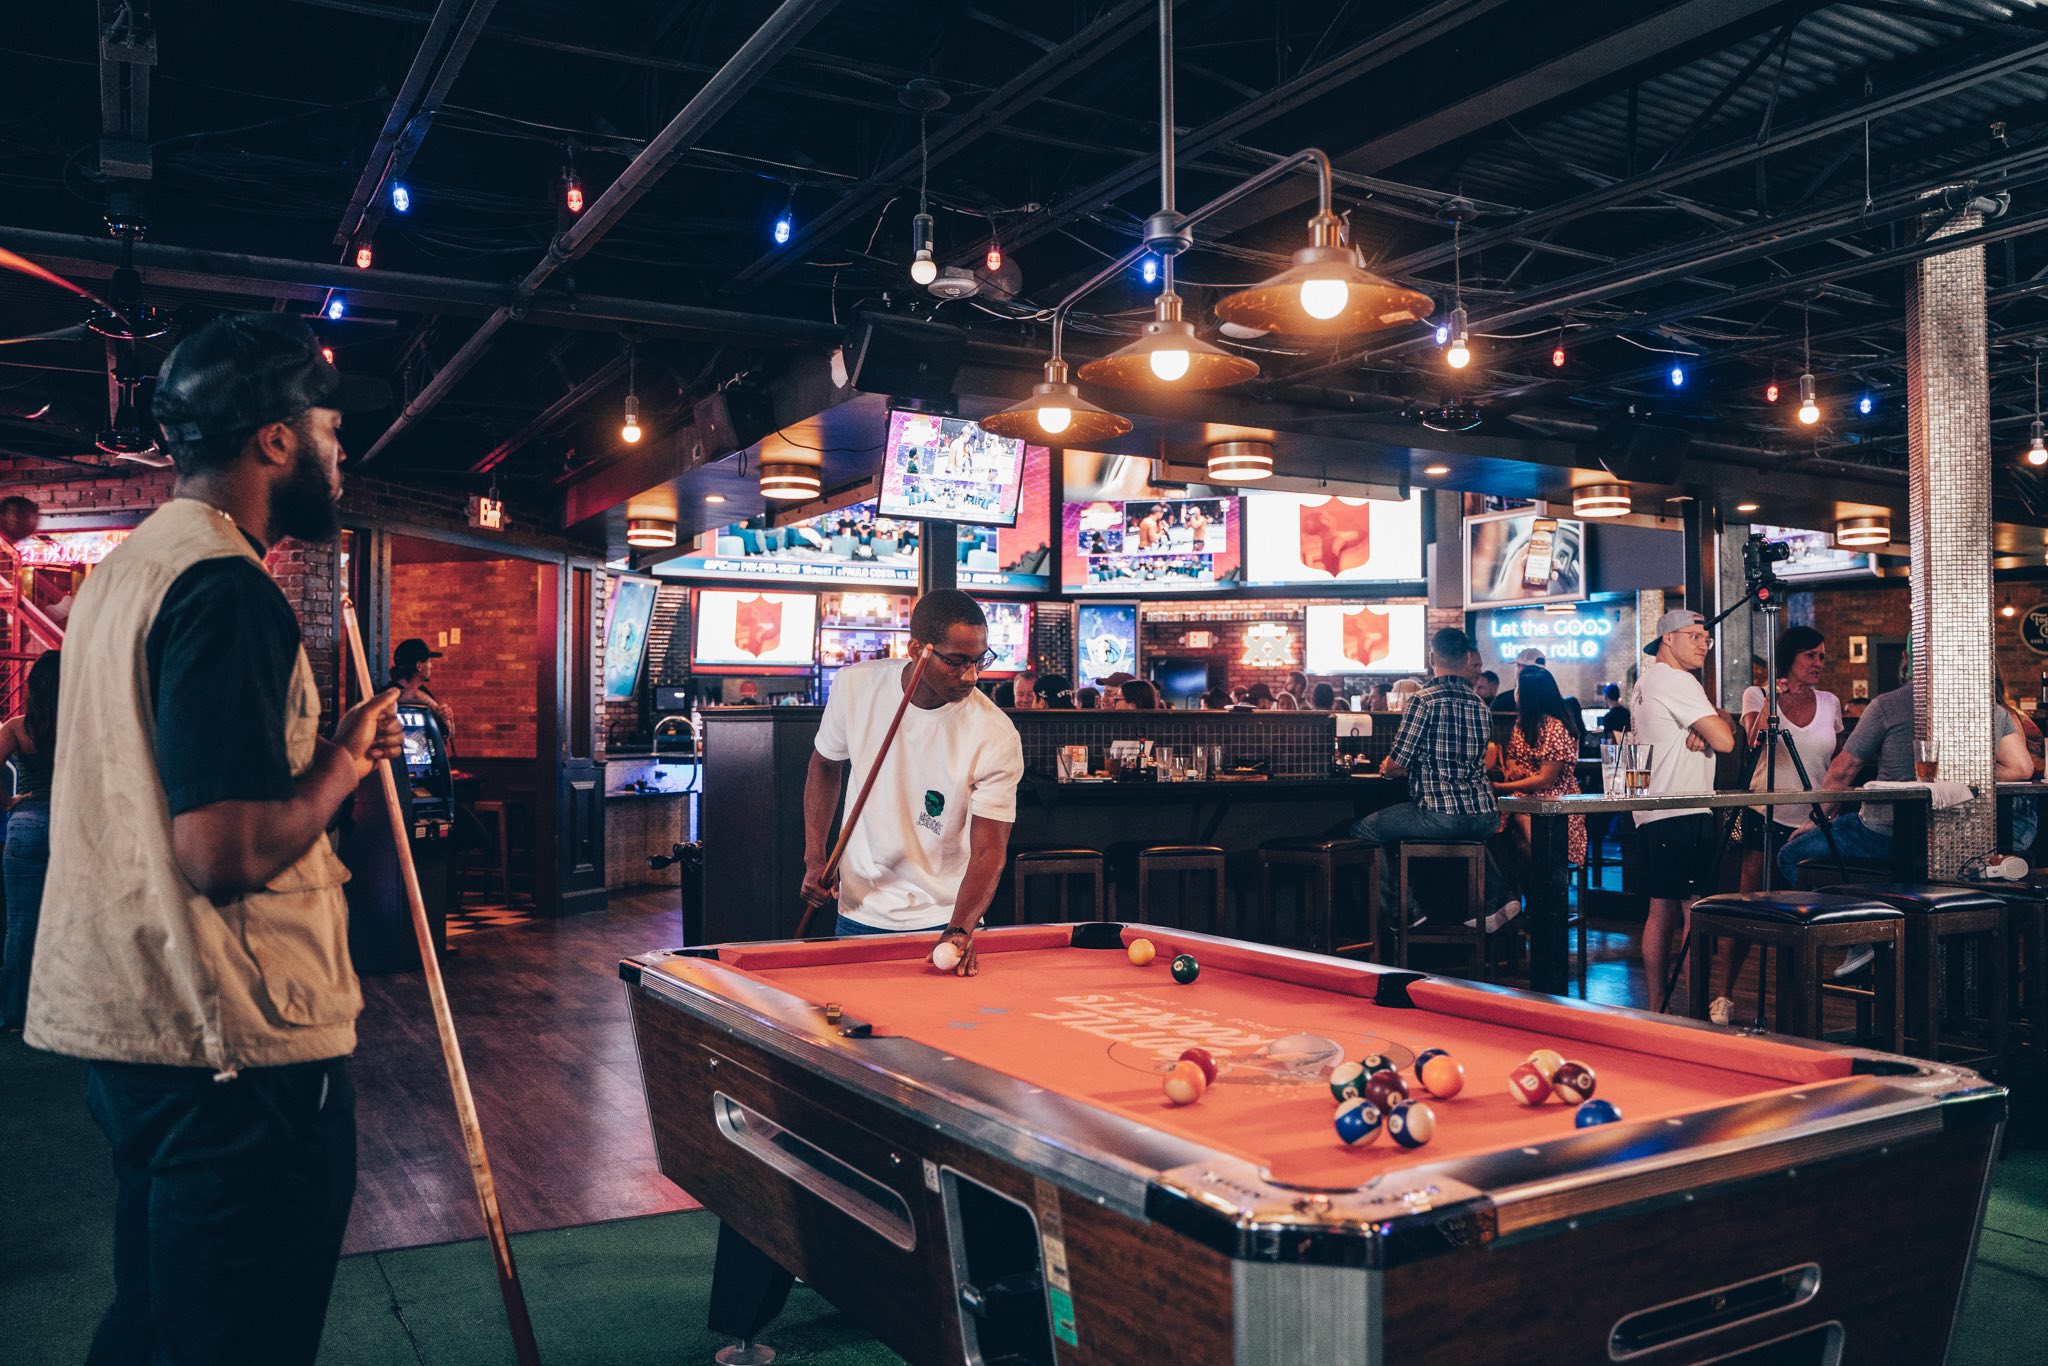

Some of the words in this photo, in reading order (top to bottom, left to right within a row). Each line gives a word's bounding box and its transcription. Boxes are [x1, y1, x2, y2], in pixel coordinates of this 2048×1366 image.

[741, 562, 800, 574] PAY-PER-VIEW
[870, 568, 897, 579] COSTA
[1491, 619, 1519, 637] Let
[1521, 619, 1549, 636] the
[1554, 618, 1612, 636] GOOD
[1551, 641, 1579, 658] roll
[1055, 994, 1278, 1047] ROCKETS
